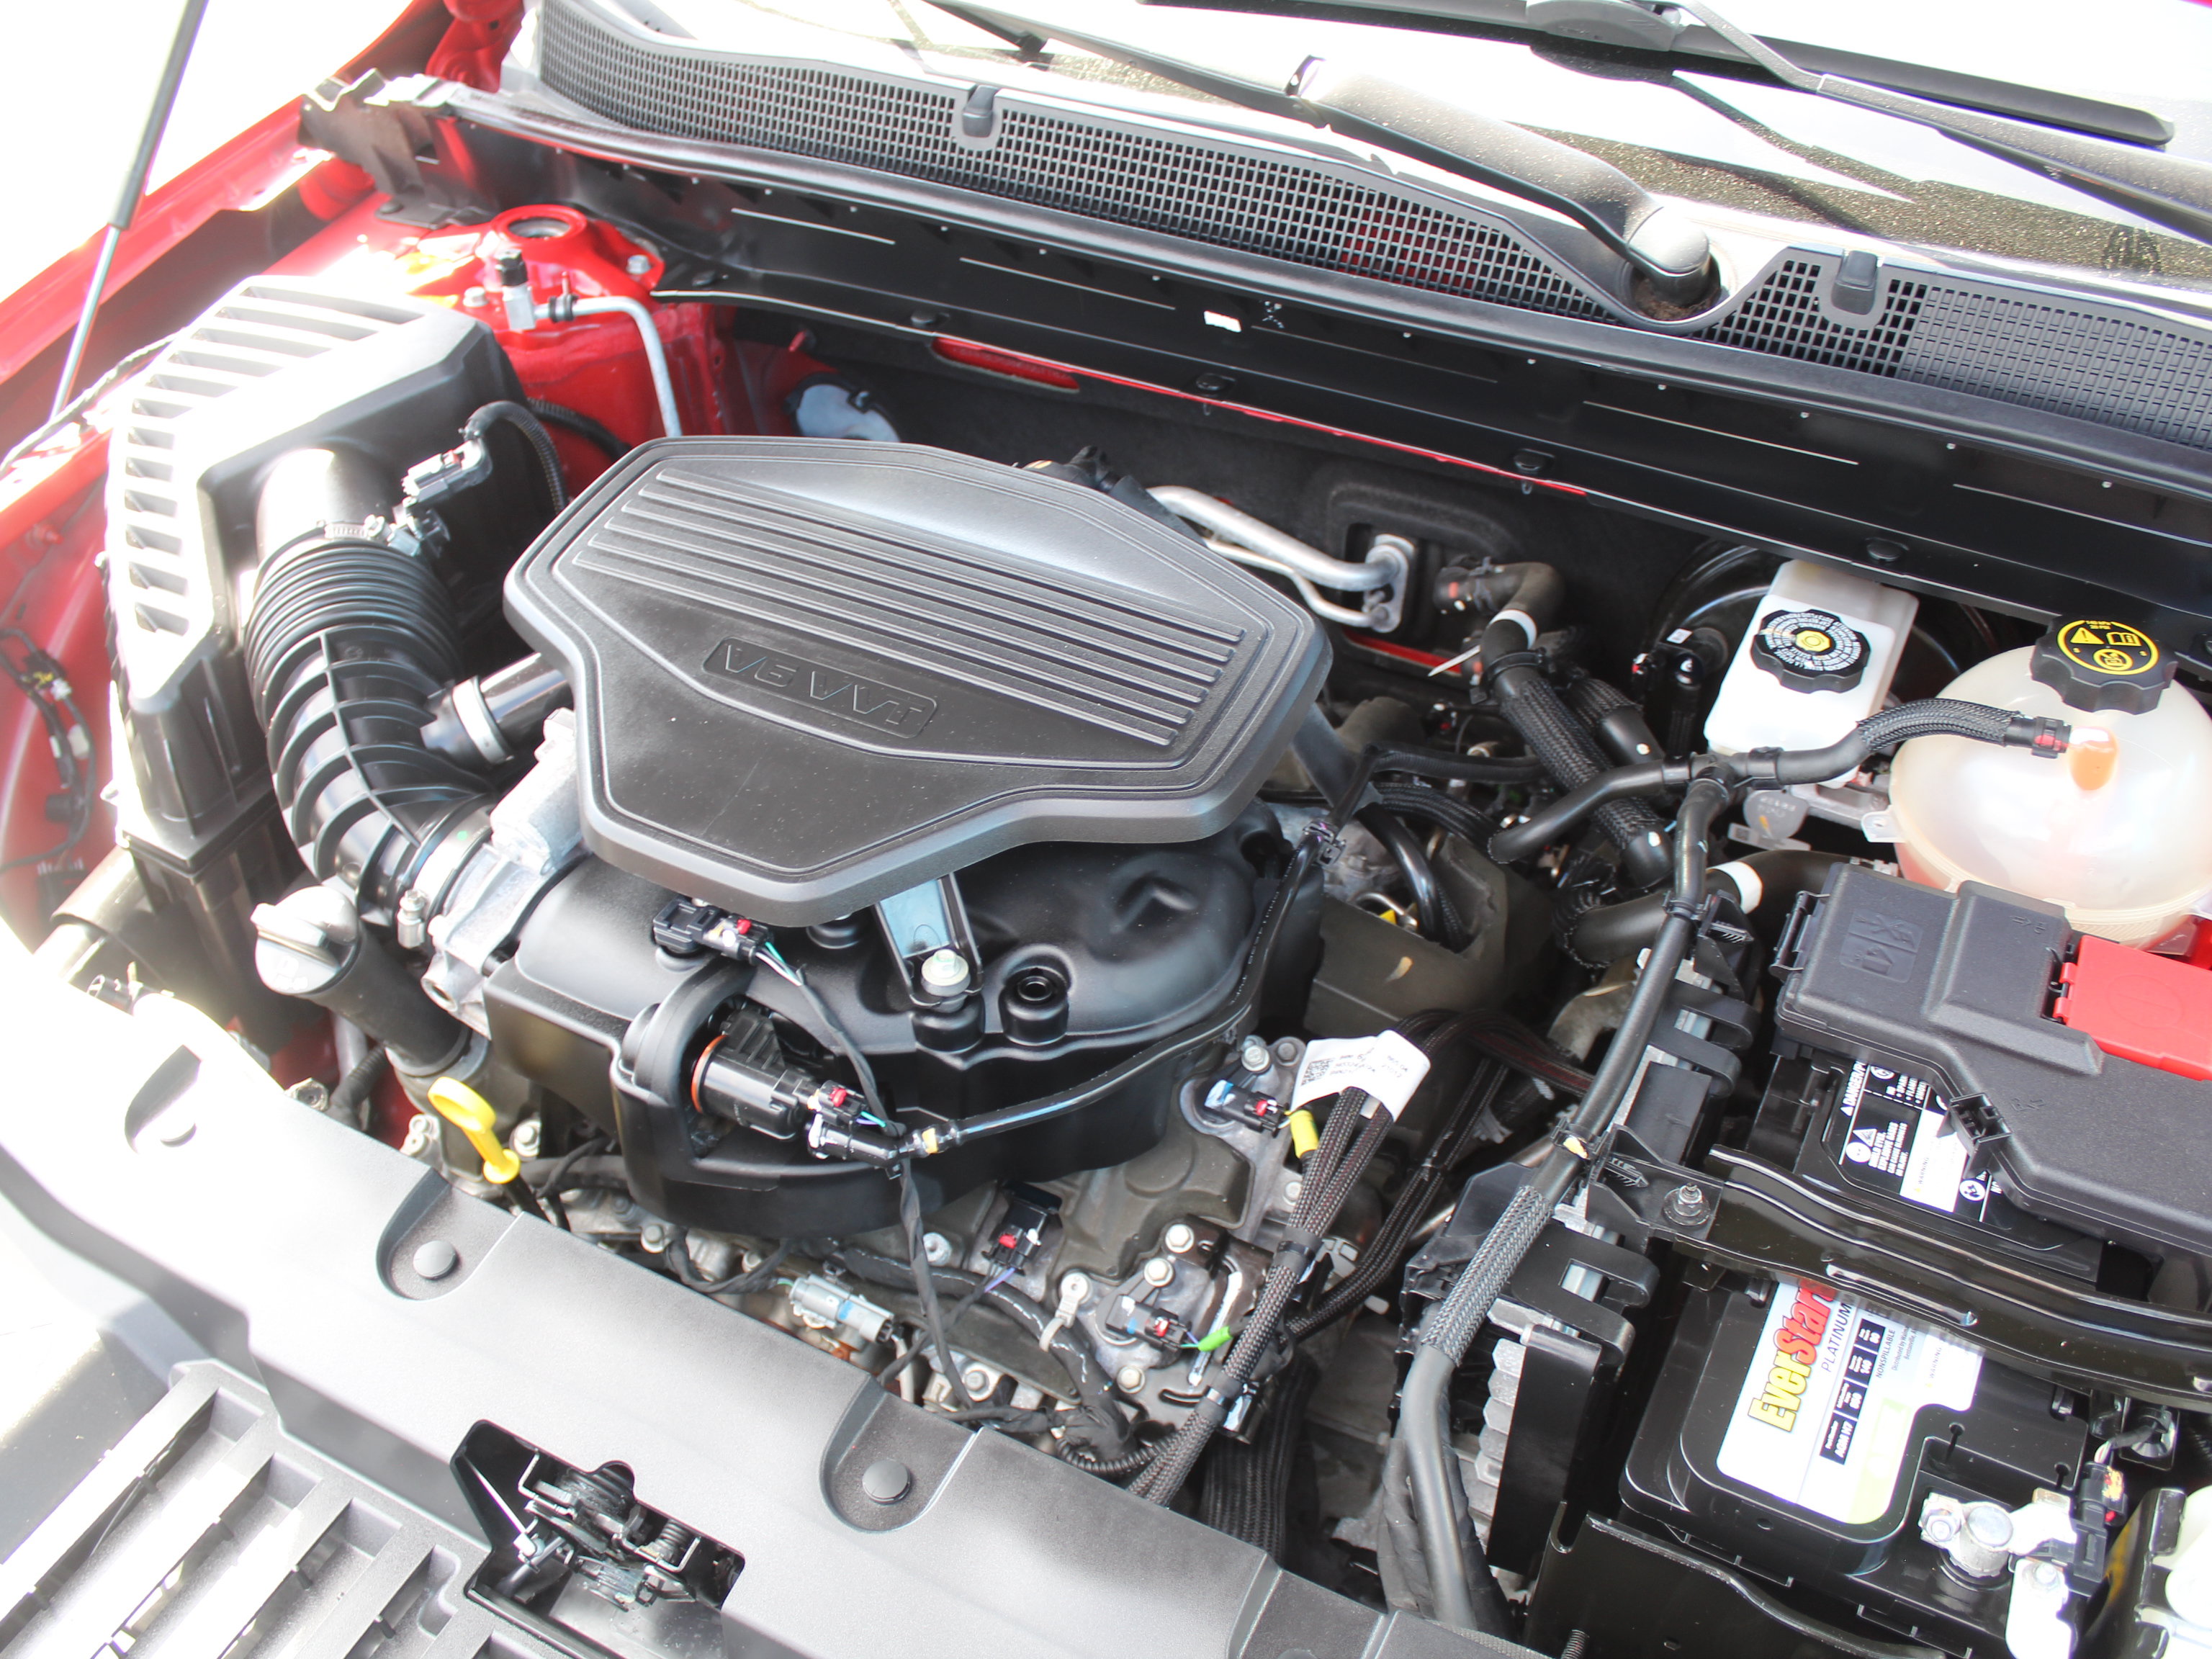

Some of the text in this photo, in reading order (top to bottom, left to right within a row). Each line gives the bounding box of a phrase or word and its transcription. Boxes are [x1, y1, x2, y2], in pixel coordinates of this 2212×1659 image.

[724, 644, 797, 687] V6
[1842, 1060, 1867, 1107] DANGER/P
[1821, 1301, 1852, 1373] PLATINUM
[1874, 1328, 1896, 1378] NONSPILLABLE
